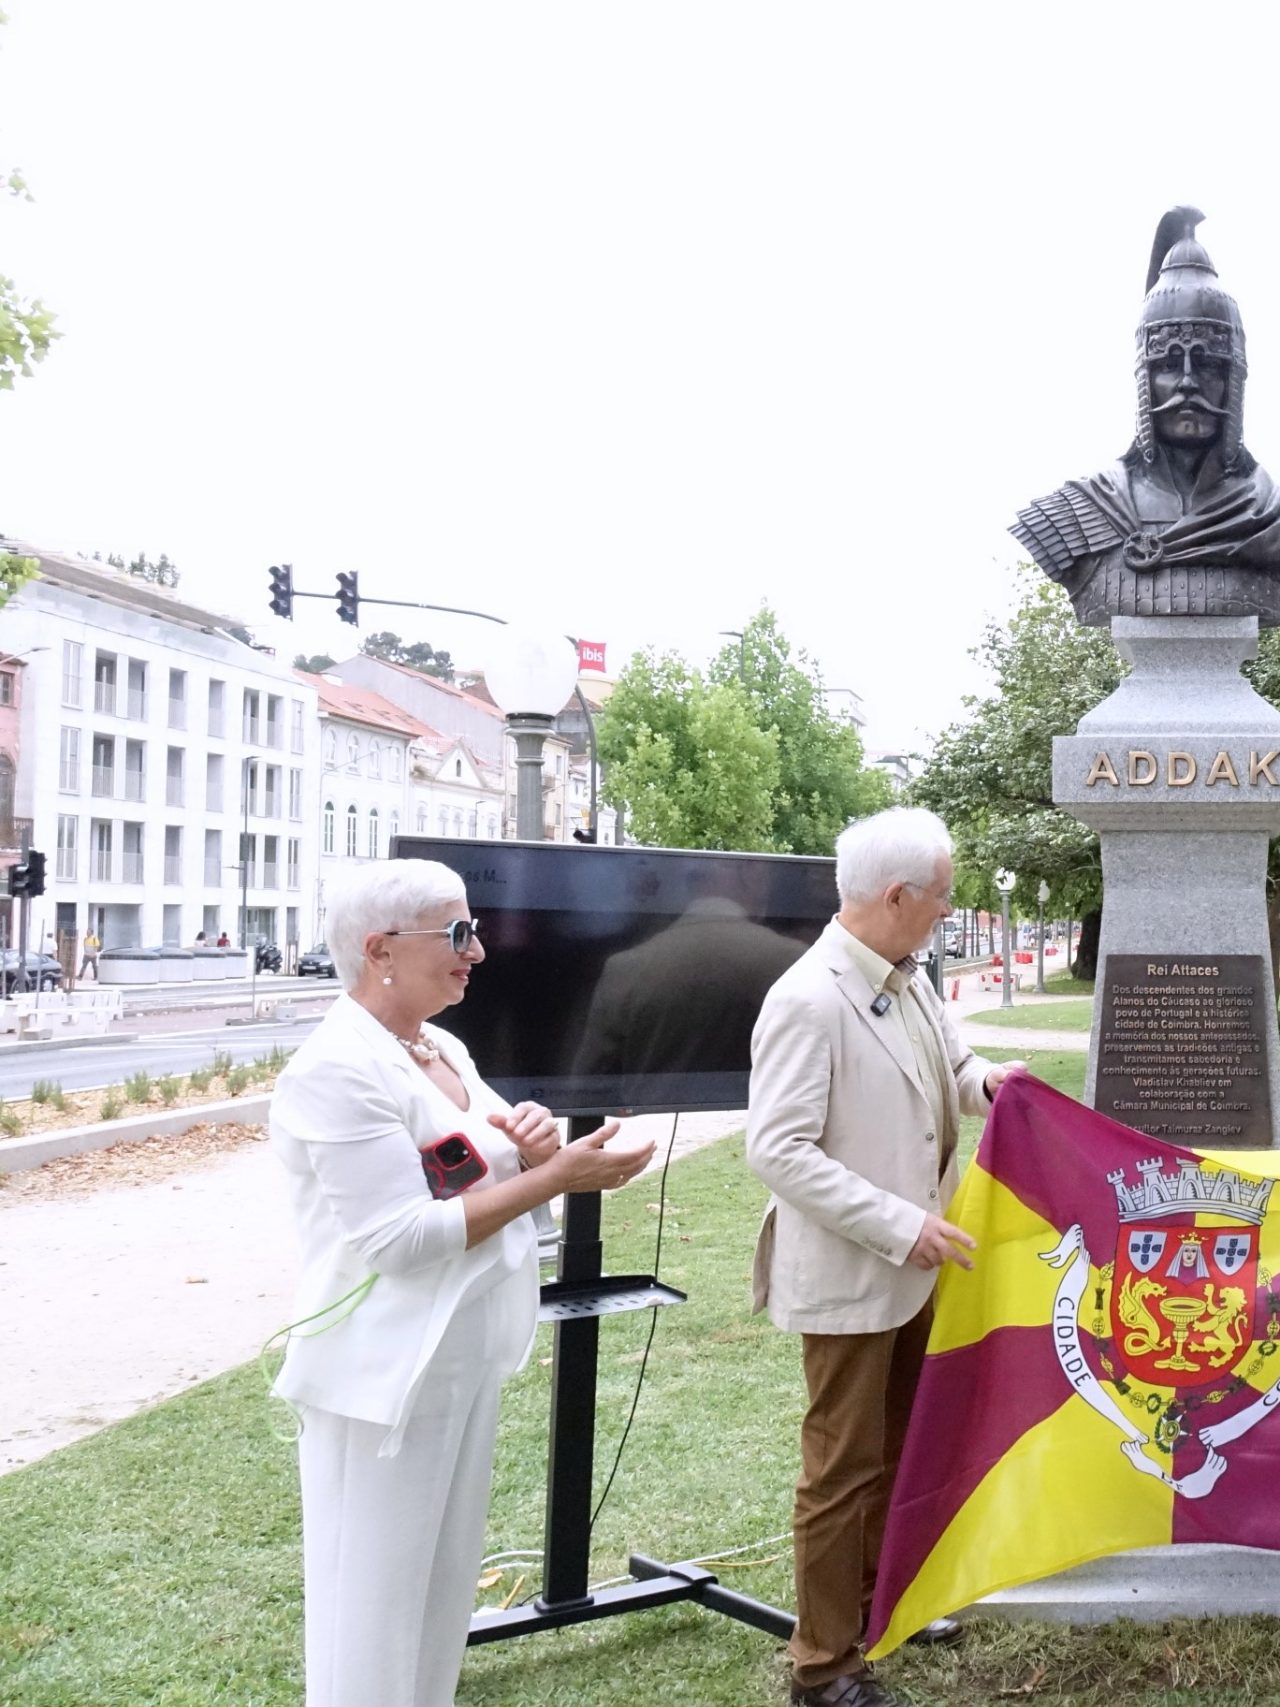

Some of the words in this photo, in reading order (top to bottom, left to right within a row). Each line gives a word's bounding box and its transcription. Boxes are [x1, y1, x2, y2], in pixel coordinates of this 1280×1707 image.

[582, 647, 603, 662] ibis
[1086, 751, 1280, 786] ADDAK
[1147, 964, 1168, 976] Rei
[1171, 964, 1220, 976] Attaces
[1112, 984, 1131, 994] Dos
[1133, 985, 1196, 995] descendentes
[1198, 986, 1215, 995] dos
[1217, 986, 1254, 997] grandes
[1112, 996, 1145, 1006] Alanos
[1147, 997, 1159, 1006] do
[1202, 998, 1214, 1006] ao
[1216, 997, 1254, 1008] glorioso
[1115, 1009, 1139, 1019] povo
[1140, 1008, 1152, 1017] de
[1154, 1008, 1193, 1019] Portugal
[1114, 1020, 1145, 1029] cidade
[1147, 1020, 1159, 1029] de
[1160, 1020, 1202, 1029] Coimbra.
[1204, 1020, 1251, 1029] Honremos
[1112, 1031, 1149, 1040] memória
[1150, 1031, 1167, 1040] dos
[1168, 1032, 1199, 1040] nossos
[1164, 1044, 1175, 1052] as
[1124, 1055, 1187, 1064] transmitamos
[1188, 1055, 1233, 1064] sabedoria
[1102, 1066, 1168, 1075] conhecimento
[1133, 1078, 1175, 1087] Vladislav
[1218, 1079, 1232, 1087] em
[1197, 1090, 1217, 1098] com
[1150, 1101, 1194, 1112] Municipal
[1196, 1101, 1208, 1110] de
[1056, 1297, 1092, 1388] CIDADE
